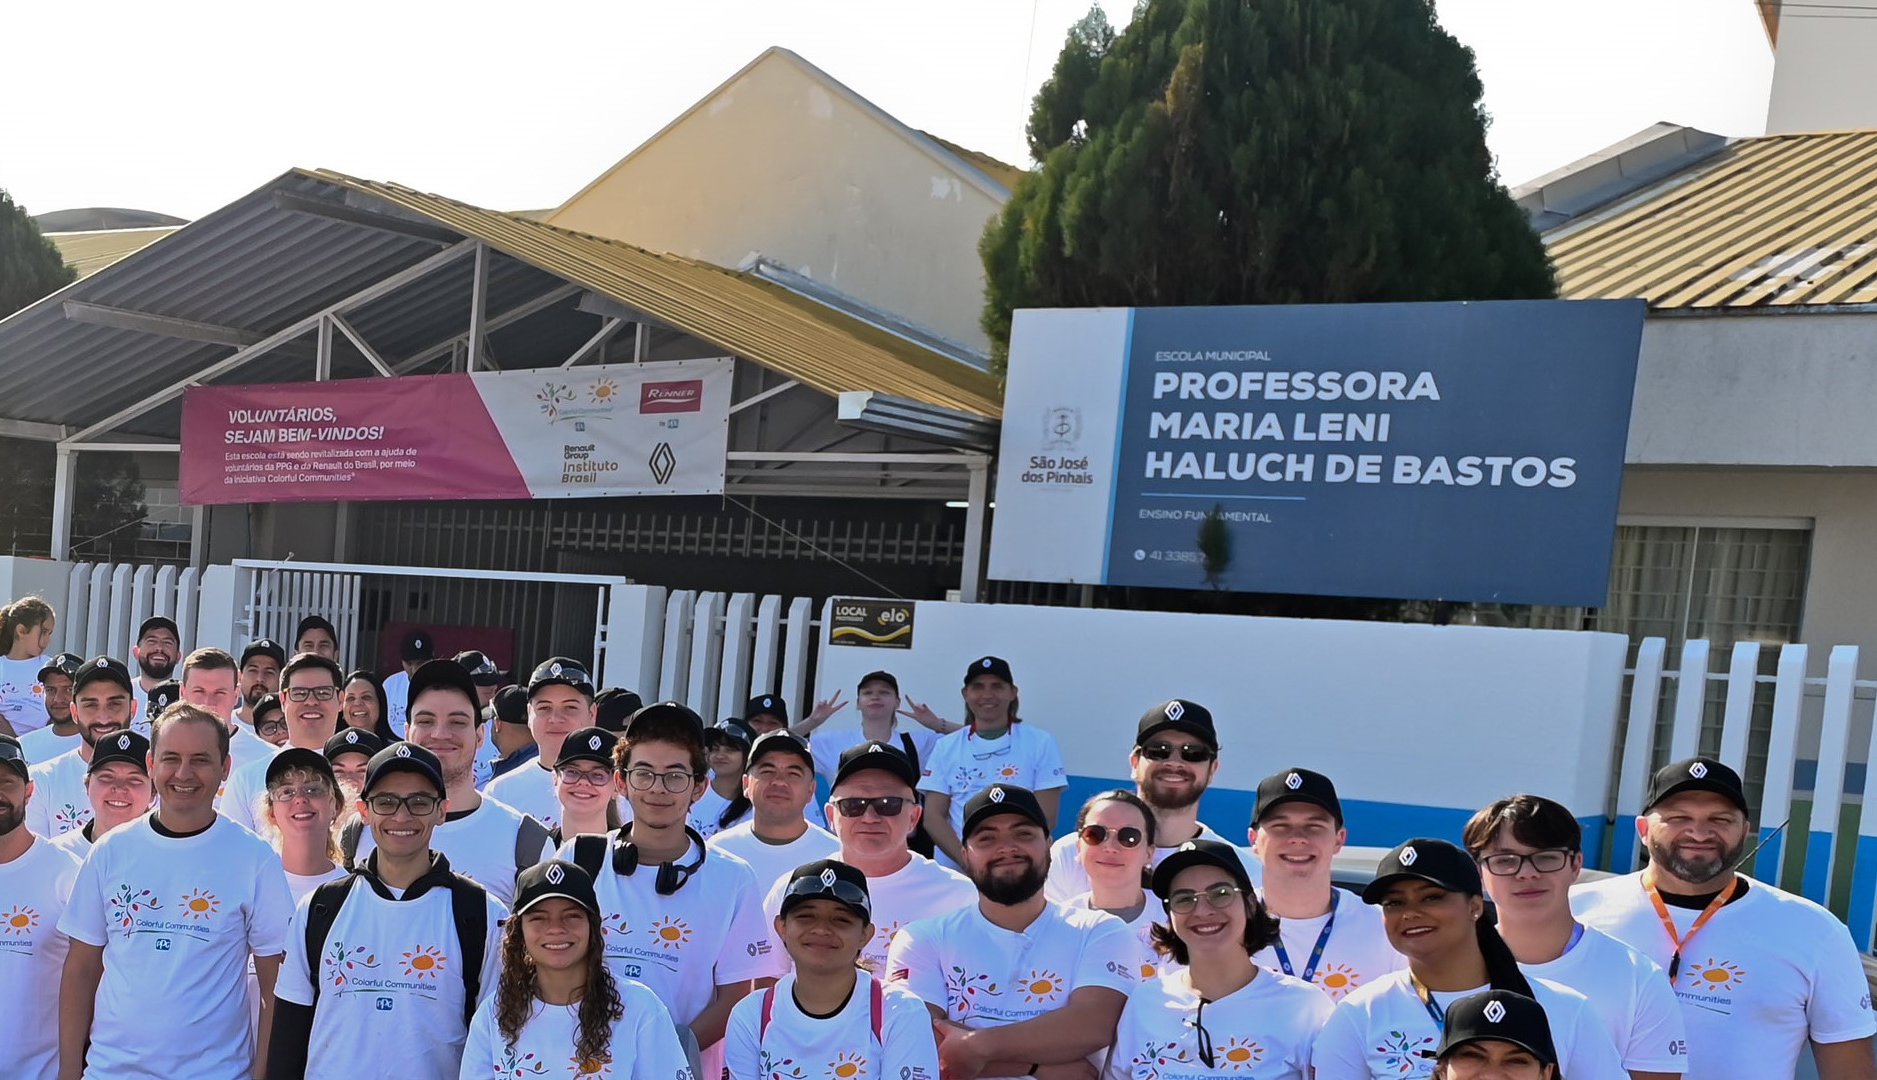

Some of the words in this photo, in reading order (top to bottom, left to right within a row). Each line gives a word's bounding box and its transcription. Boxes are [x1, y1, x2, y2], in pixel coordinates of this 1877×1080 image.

[1155, 351, 1203, 362] ESCOLA
[1206, 351, 1270, 362] MUNICIPAL
[1153, 371, 1440, 400] PROFESSORA
[648, 389, 694, 398] RENNER
[229, 406, 337, 424] VOLUNTÁRIOS,
[1149, 411, 1285, 440] MARIA
[1293, 413, 1390, 442] LENI
[224, 430, 275, 443] SEJAM
[278, 426, 384, 442] BEM-VINDOS!
[225, 452, 240, 460] Esta
[242, 452, 266, 460] escola
[267, 451, 285, 459] está
[286, 451, 309, 459] sendo
[311, 449, 353, 458] revitalizada
[381, 448, 404, 457] ajuda
[406, 448, 417, 456] de
[564, 444, 595, 452] Renault
[564, 452, 589, 460] Group
[225, 463, 263, 472] voluntários
[265, 462, 274, 471] da
[276, 462, 292, 470] PPG
[301, 462, 311, 470] da
[313, 461, 342, 469] Renault
[344, 460, 354, 469] do
[355, 460, 378, 470] Brasil,
[380, 461, 393, 470] por
[395, 459, 415, 468] meio
[563, 460, 618, 472] Instituto
[1030, 456, 1056, 469] São
[1058, 456, 1089, 470] José
[1145, 451, 1314, 481] HALUCH
[1324, 454, 1382, 483] DE
[1392, 456, 1576, 488] BASTOS
[224, 476, 233, 484] da
[234, 474, 266, 483] iniciativa
[268, 474, 297, 482] Colorful
[561, 473, 597, 483] Brasil
[1022, 471, 1044, 482] dos
[1047, 472, 1093, 484] Pinhais
[1139, 509, 1182, 520] ENSINO
[1184, 511, 1272, 522] FUNAMENTAL
[1149, 552, 1162, 560] 41
[836, 606, 867, 616] LOCAL
[881, 608, 905, 622] elo
[136, 919, 163, 929] Colorful
[165, 922, 210, 933] Communities
[156, 939, 171, 950] PPG
[605, 944, 632, 954] Colorful
[625, 965, 641, 977] PPG
[352, 978, 383, 986] Colorful
[386, 980, 436, 991] Communities
[376, 997, 393, 1010] PPG
[973, 1003, 1003, 1014] Colorful
[1162, 1073, 1195, 1080] Colorful
